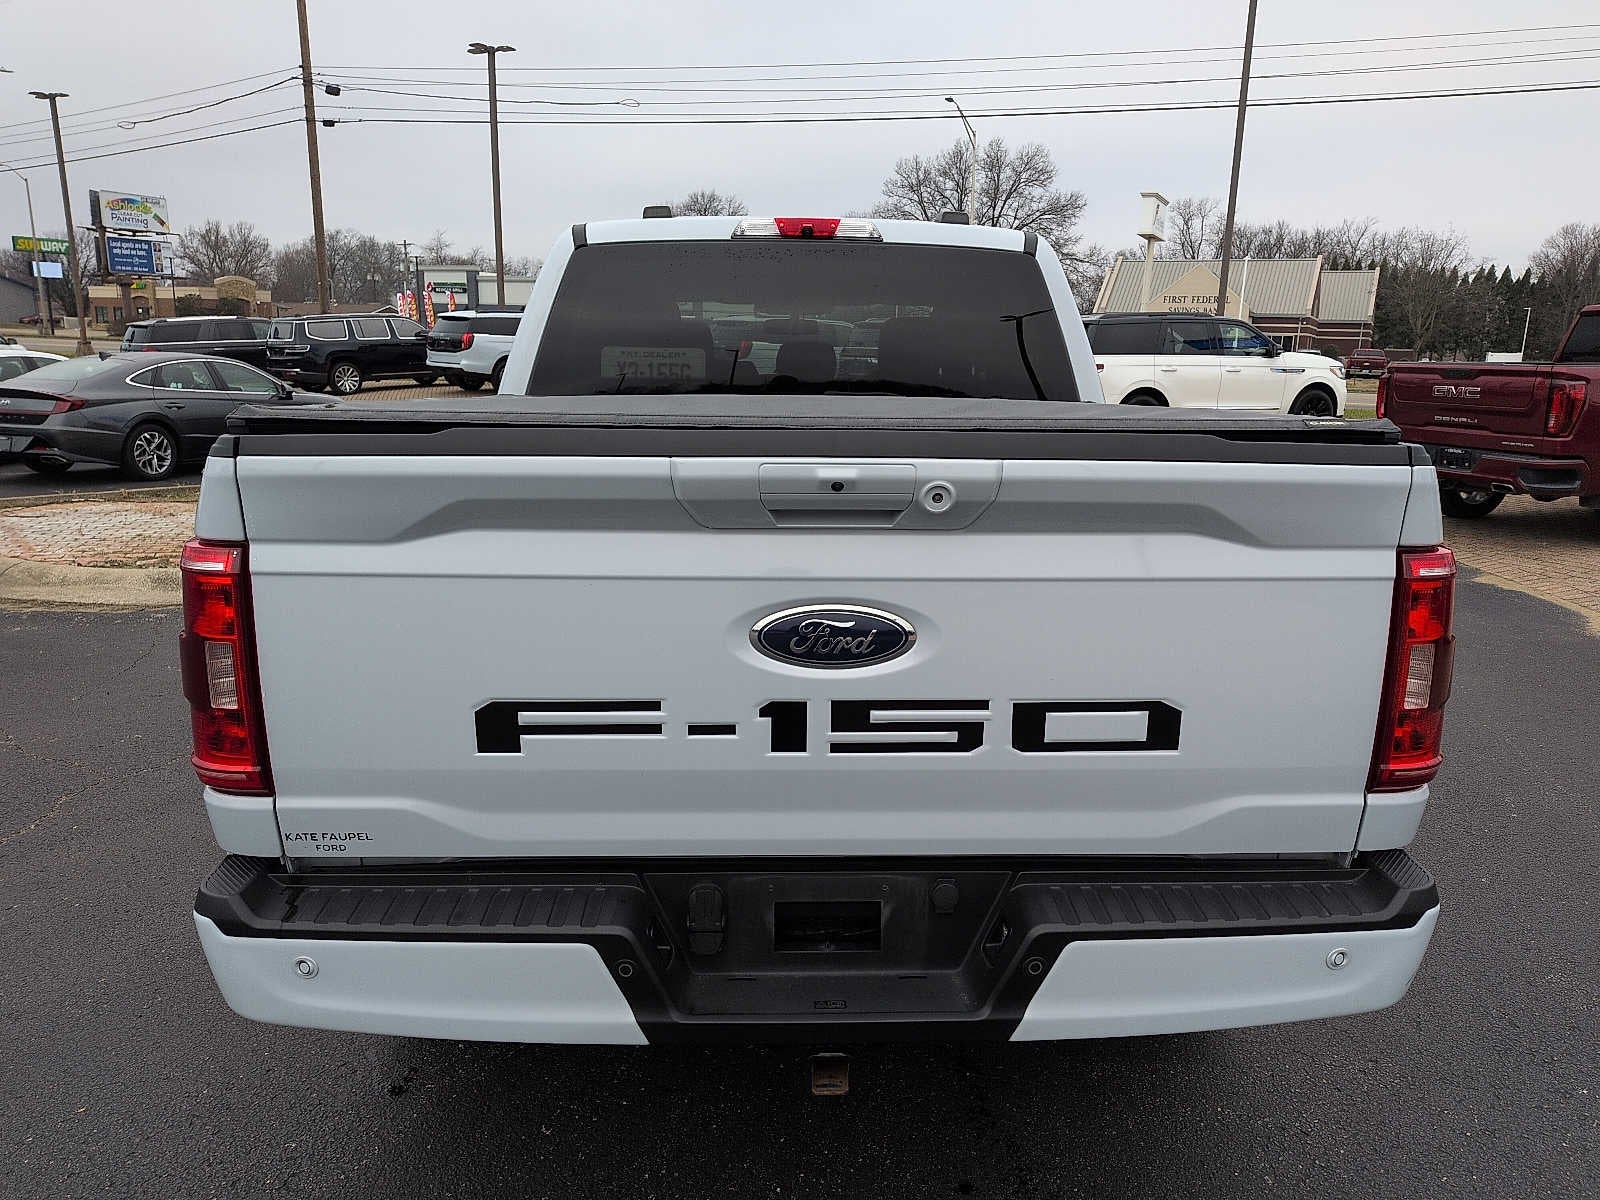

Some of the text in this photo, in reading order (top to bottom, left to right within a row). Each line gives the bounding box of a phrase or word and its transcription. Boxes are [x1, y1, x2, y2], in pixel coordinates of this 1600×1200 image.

[1163, 295, 1232, 304] FIRST FEDERL
[1432, 385, 1481, 399] GMC
[1434, 415, 1478, 424] DENALI
[789, 618, 878, 656] Ford
[473, 699, 1183, 755] F-150
[284, 832, 374, 842] KATE FAUPEL
[315, 844, 347, 852] FORD
